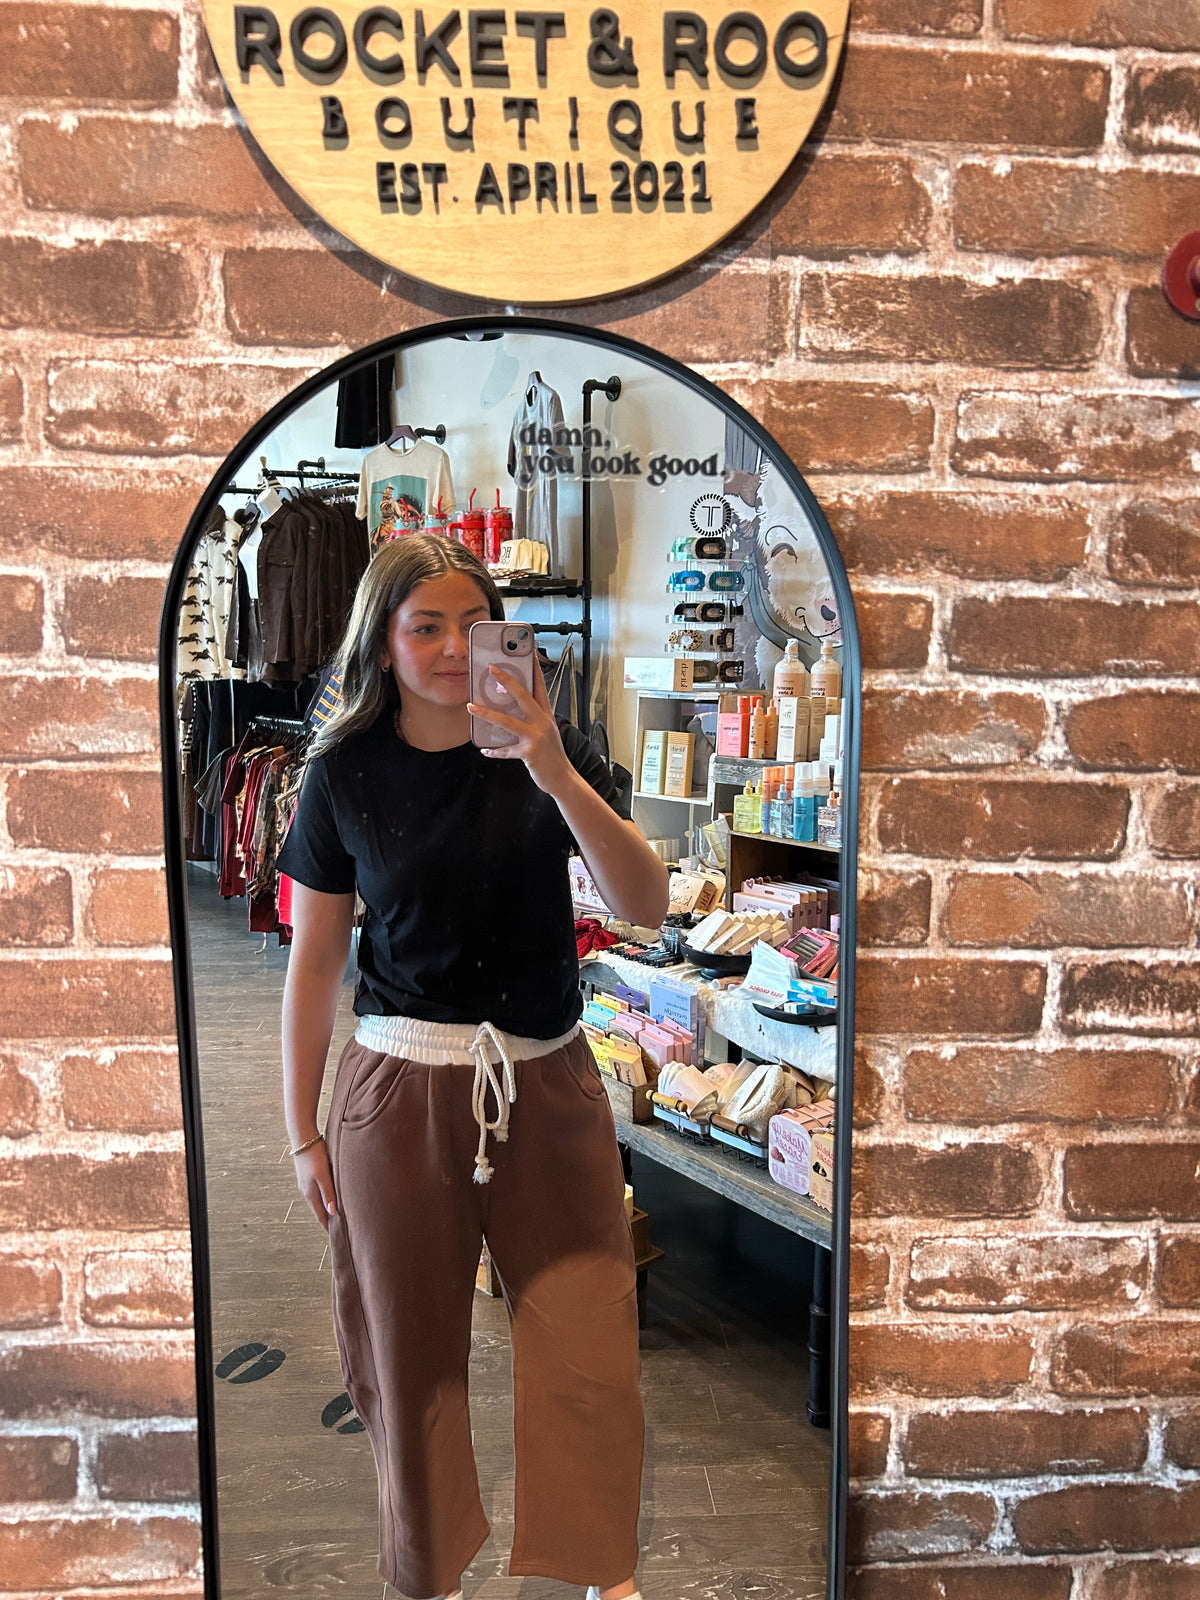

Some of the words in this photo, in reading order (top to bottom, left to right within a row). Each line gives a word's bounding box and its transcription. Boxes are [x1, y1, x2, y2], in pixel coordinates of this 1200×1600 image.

[233, 7, 566, 80] ROCKET
[587, 8, 639, 77] &
[662, 10, 829, 80] ROO
[320, 95, 759, 148] BOUTIQUE
[376, 161, 460, 205] EST.
[475, 162, 598, 204] APRIL
[610, 161, 713, 204] 2021
[520, 423, 611, 450] damn,
[523, 453, 575, 483] you
[582, 452, 641, 476] look
[648, 453, 727, 486] good.
